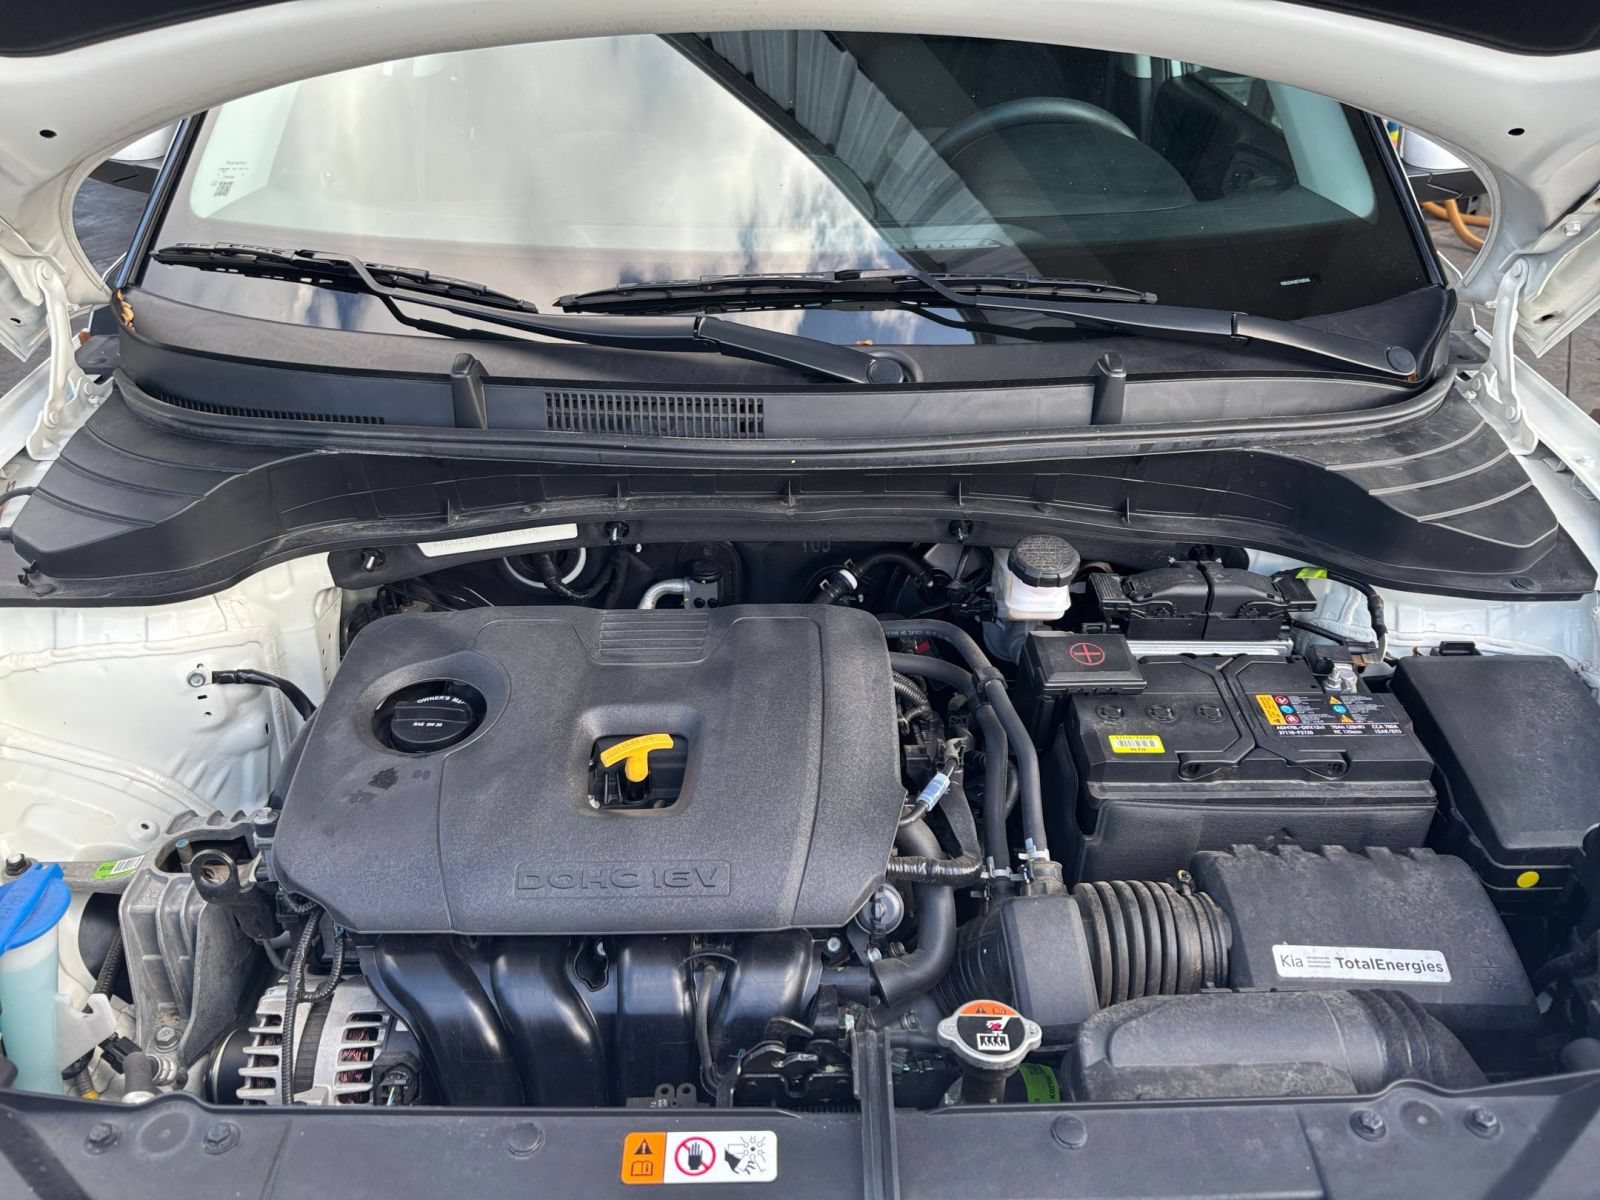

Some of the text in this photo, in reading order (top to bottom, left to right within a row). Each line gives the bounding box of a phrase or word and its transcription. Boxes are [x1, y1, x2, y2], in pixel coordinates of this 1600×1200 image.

[417, 695, 451, 704] OWNER'S
[516, 866, 718, 890] DOHC 16V
[1280, 954, 1444, 974] Kia TotalEnergies
